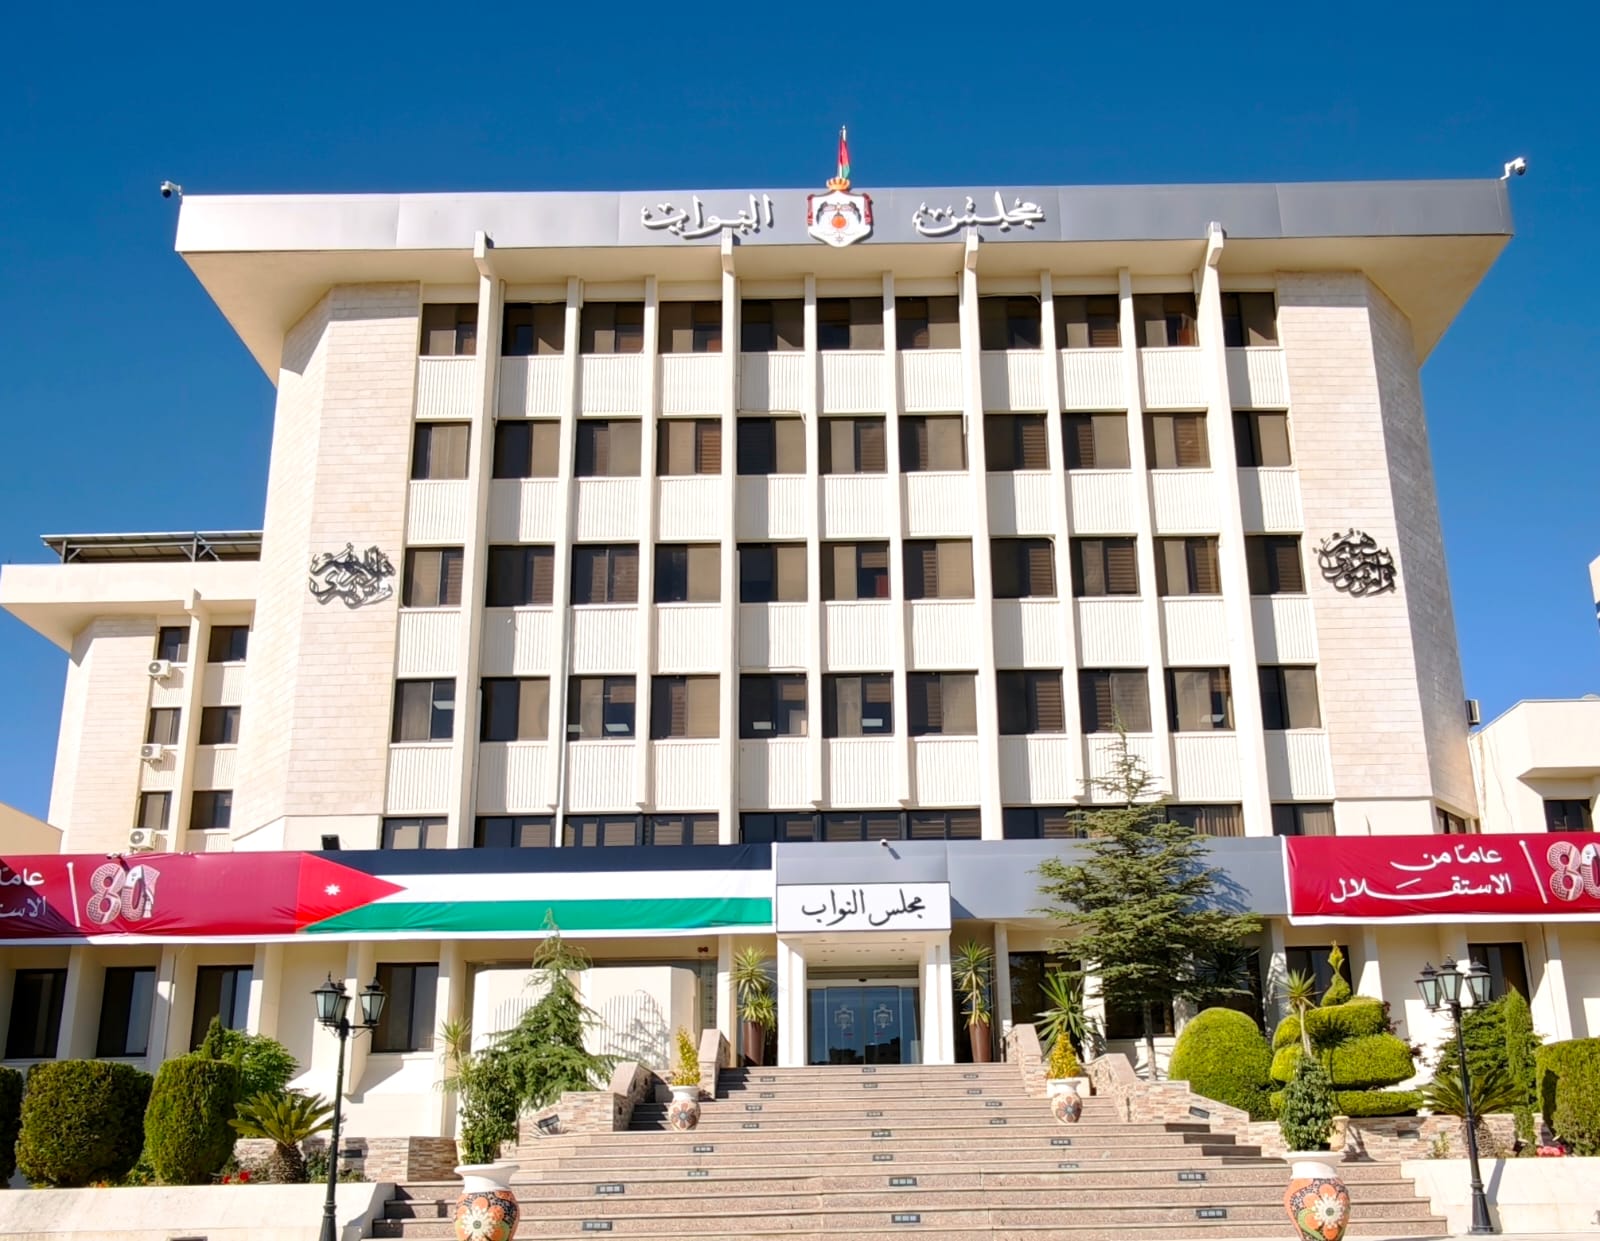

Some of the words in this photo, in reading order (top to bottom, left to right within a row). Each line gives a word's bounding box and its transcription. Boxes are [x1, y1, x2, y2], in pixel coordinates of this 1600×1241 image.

[641, 192, 771, 237] النواب
[912, 190, 1044, 233] مجلس
[1390, 851, 1452, 872] من
[86, 863, 160, 926] 80
[801, 888, 866, 927] النواب
[868, 887, 926, 926] مجلس
